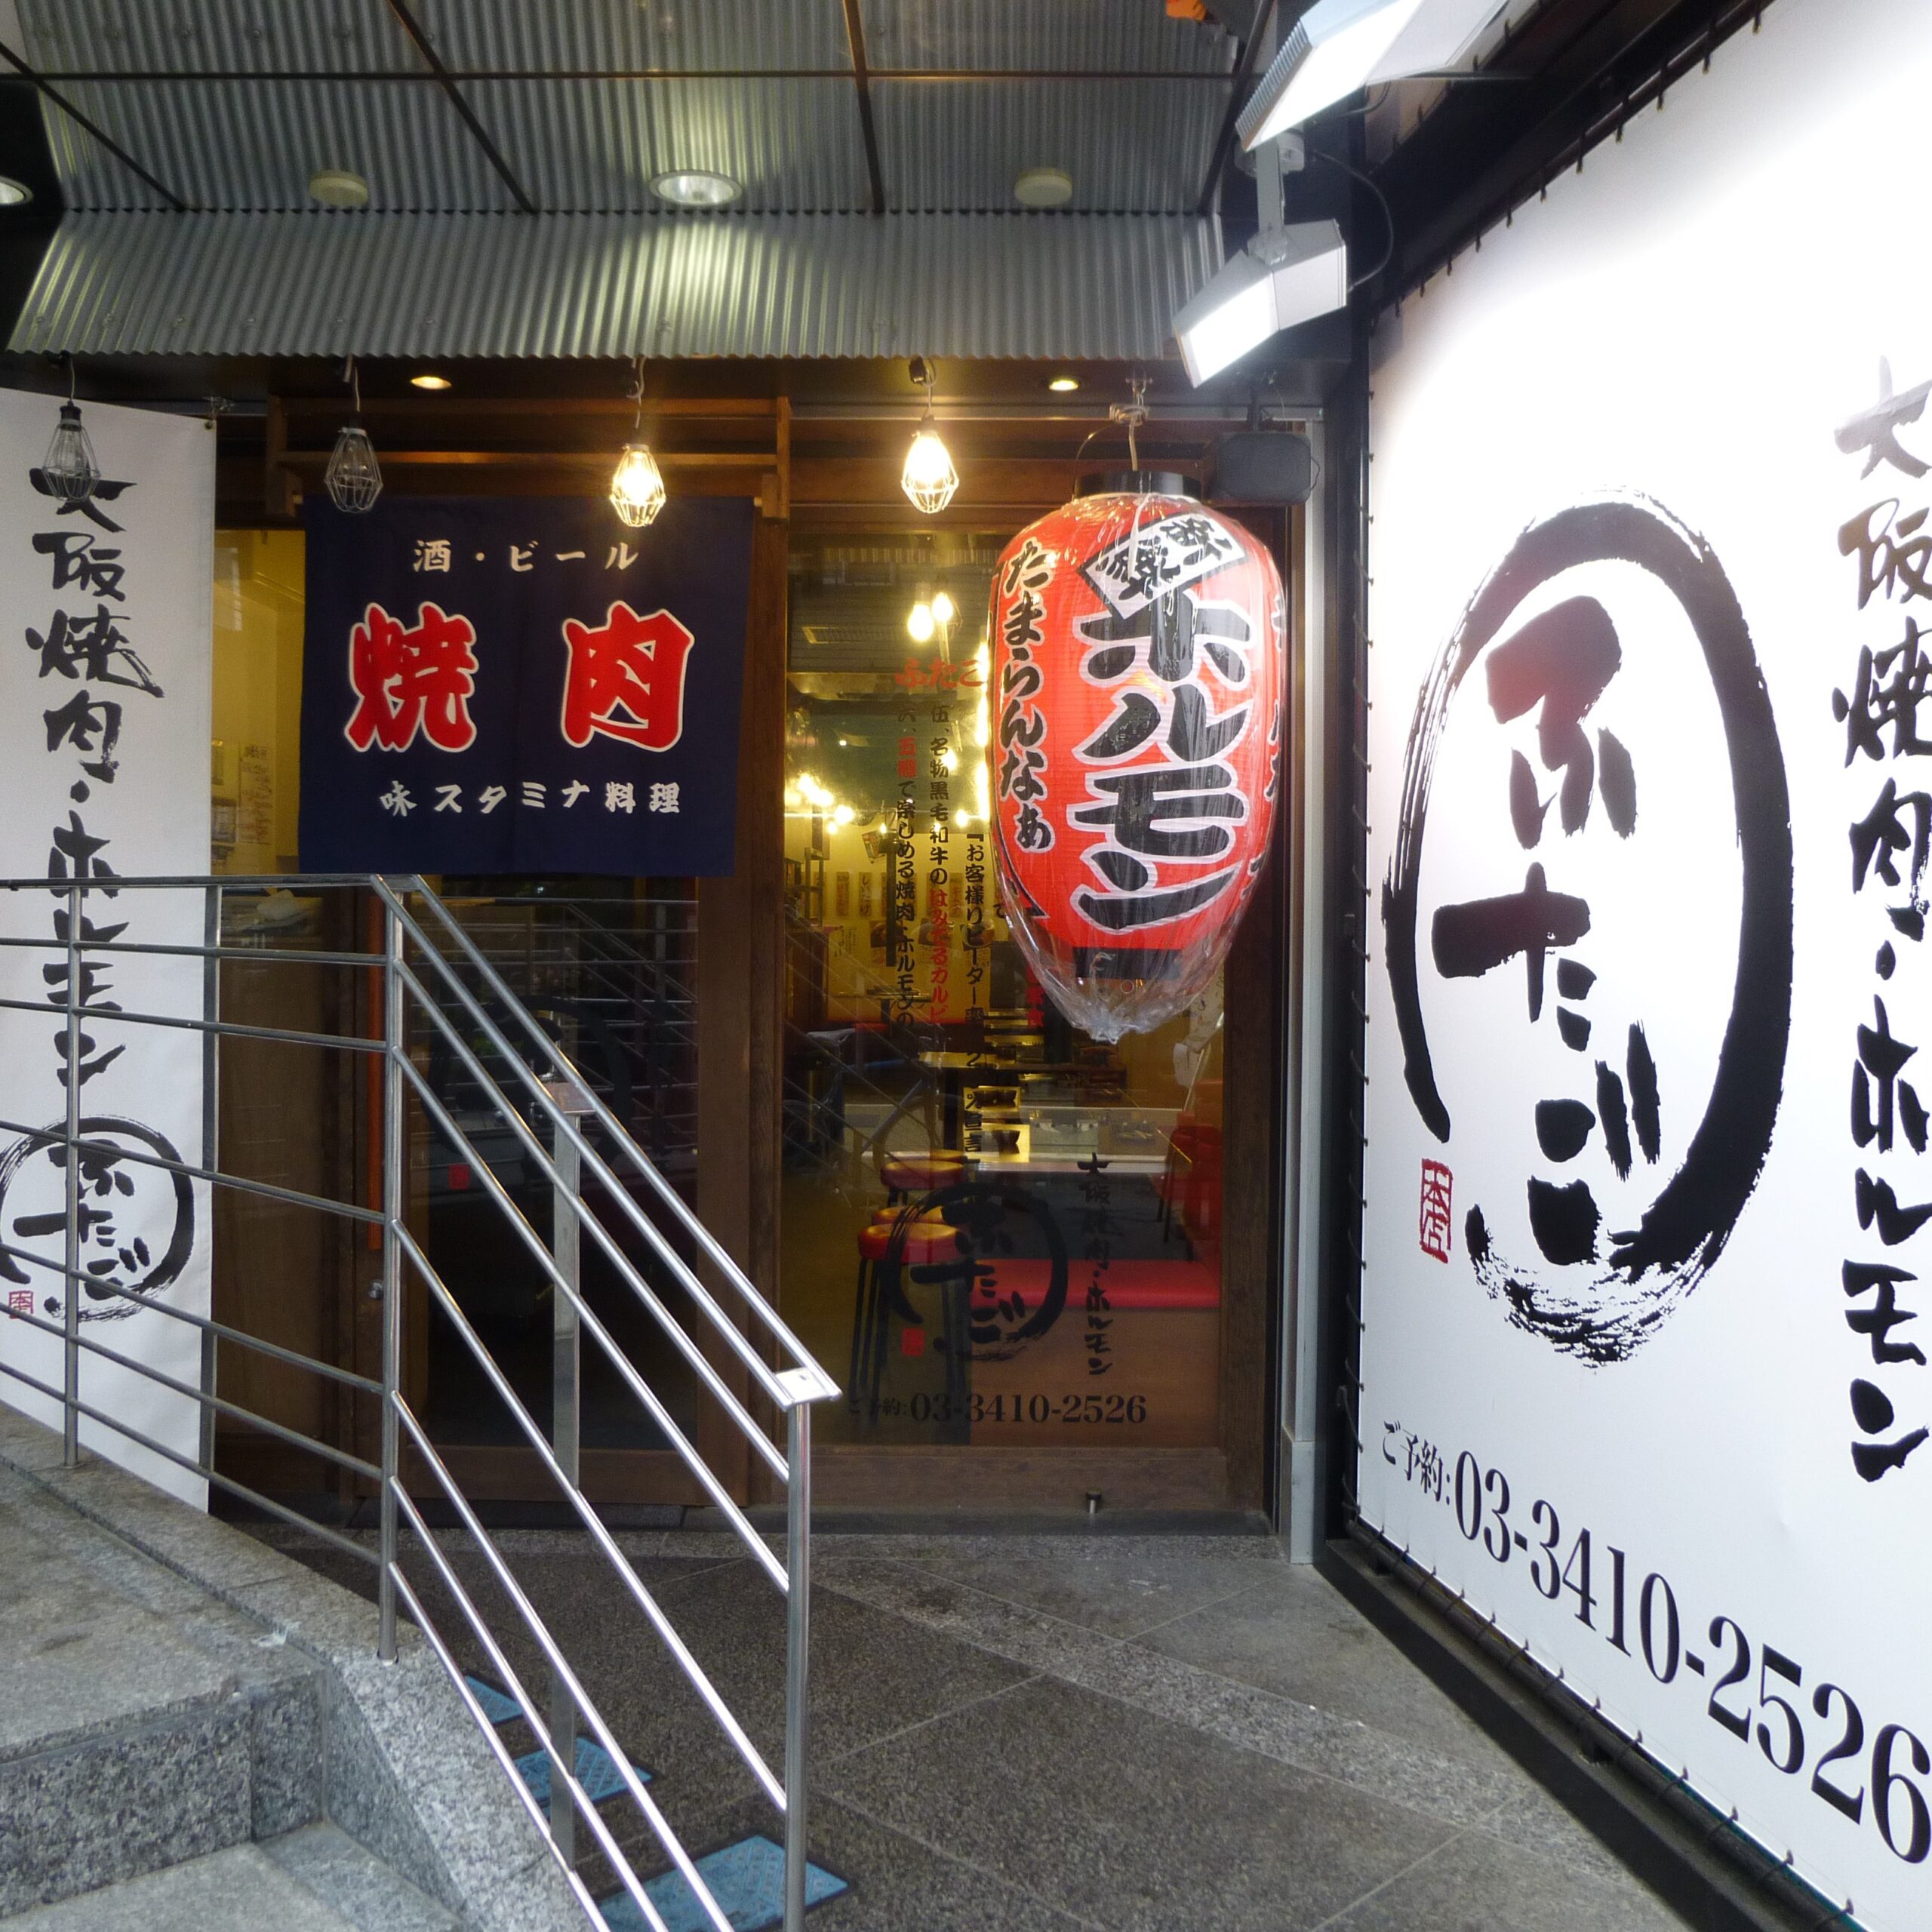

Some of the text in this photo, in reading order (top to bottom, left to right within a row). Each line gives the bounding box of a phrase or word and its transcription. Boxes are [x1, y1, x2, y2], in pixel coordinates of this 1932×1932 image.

[413, 539, 638, 573] 酒・ビール
[1095, 517, 1233, 601] 新鮮
[344, 601, 695, 753] 焼肉
[25, 459, 164, 1087] 大阪焼肉・ホルモン
[379, 780, 680, 817] 味スタミナ料理
[1070, 592, 1254, 933] ホルモン
[1832, 355, 1932, 1482] 大阪焼肉・ホルモン
